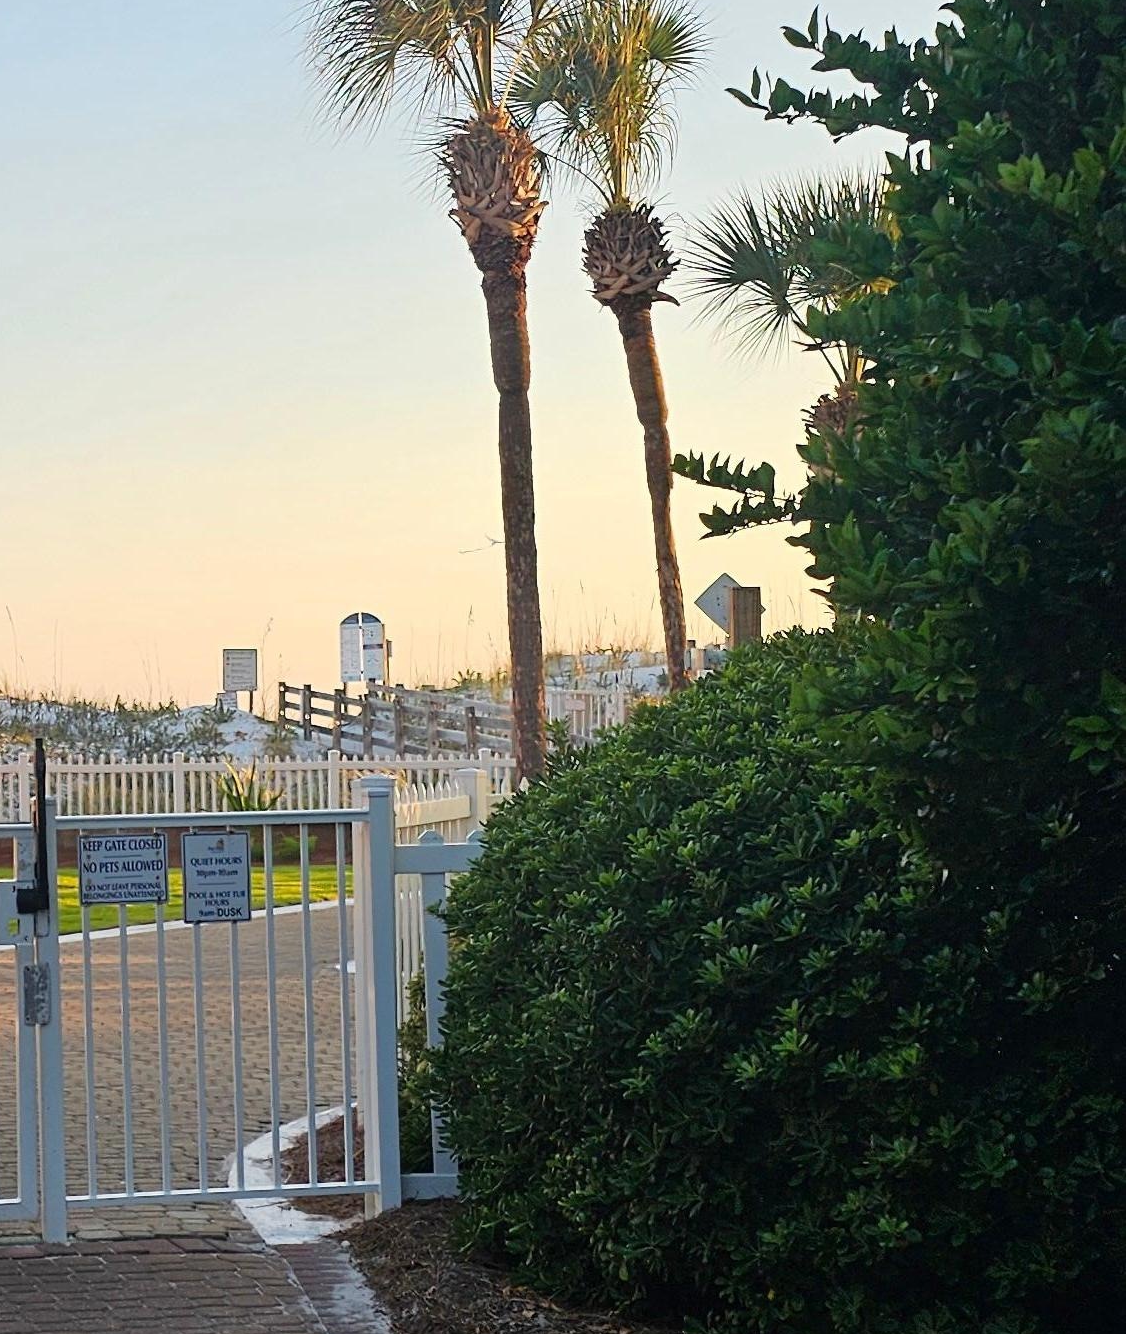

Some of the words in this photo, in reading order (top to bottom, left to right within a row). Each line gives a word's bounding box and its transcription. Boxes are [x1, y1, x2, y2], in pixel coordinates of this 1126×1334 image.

[83, 840, 103, 851] KEEP
[104, 840, 127, 851] GATE
[128, 838, 162, 850] CLOSED
[83, 862, 97, 874] NO
[99, 861, 120, 873] PETS
[121, 859, 163, 872] ALLOWED
[190, 857, 213, 866] QUIET
[215, 857, 243, 866] HOURS
[85, 884, 96, 892] DO
[97, 883, 111, 891] NOT
[130, 882, 161, 890] PERSONAL
[83, 891, 123, 900] BELONGINGS
[123, 890, 164, 899] UNATTENDED
[188, 891, 207, 899] POOL
[217, 907, 242, 917] DUSK
